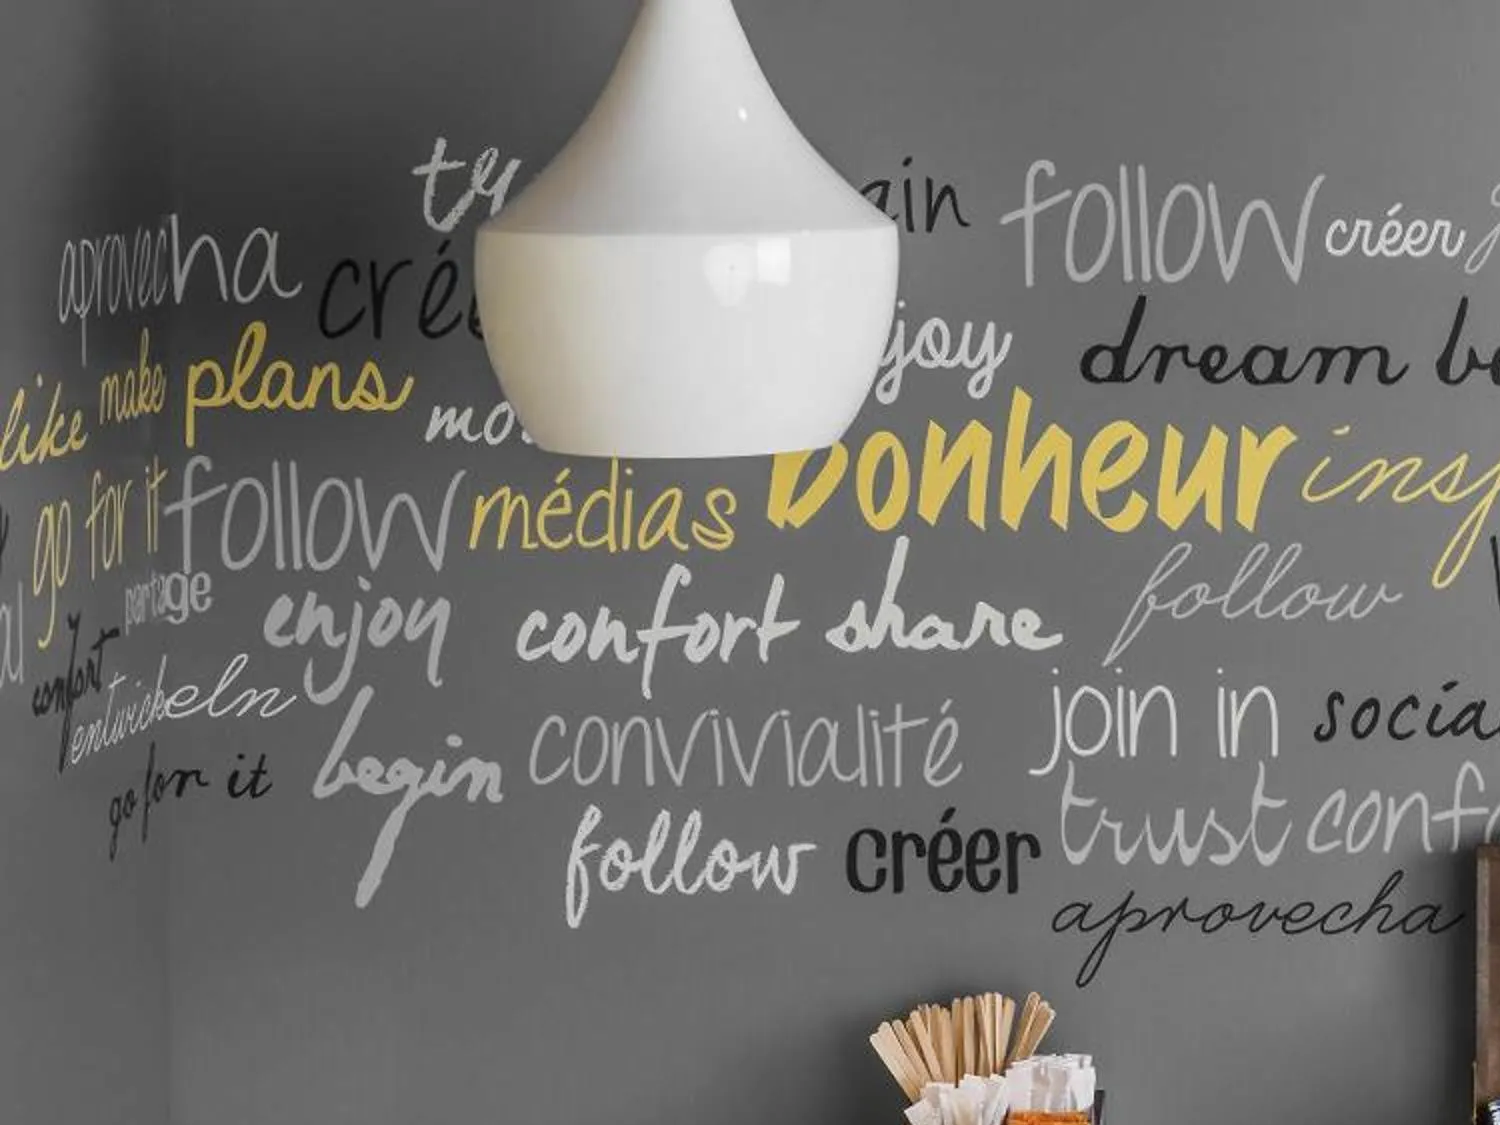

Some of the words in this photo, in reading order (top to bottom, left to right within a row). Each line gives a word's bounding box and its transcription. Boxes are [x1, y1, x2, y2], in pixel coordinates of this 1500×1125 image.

[1000, 159, 1327, 288] follow
[1325, 202, 1467, 259] créer
[57, 213, 302, 367] aprovecha
[1079, 294, 1409, 386] dream
[101, 328, 165, 424] make
[184, 321, 414, 448] plans
[33, 500, 71, 648] go
[86, 469, 132, 580] for
[146, 455, 168, 552] it
[164, 455, 467, 573] follow
[468, 455, 737, 552] médias
[125, 570, 213, 635] partage
[264, 577, 450, 704] enjoy
[516, 562, 801, 699] confort
[826, 535, 1063, 652] share
[1102, 541, 1403, 667] follow
[227, 753, 273, 800] it
[528, 698, 963, 788] convivialité
[1029, 667, 1178, 776] join
[1217, 667, 1278, 757] in
[312, 685, 503, 909] begin
[844, 807, 1041, 894] créer
[1060, 760, 1291, 866] trust
[565, 803, 816, 928] follow
[1052, 869, 1465, 988] aprovecha
